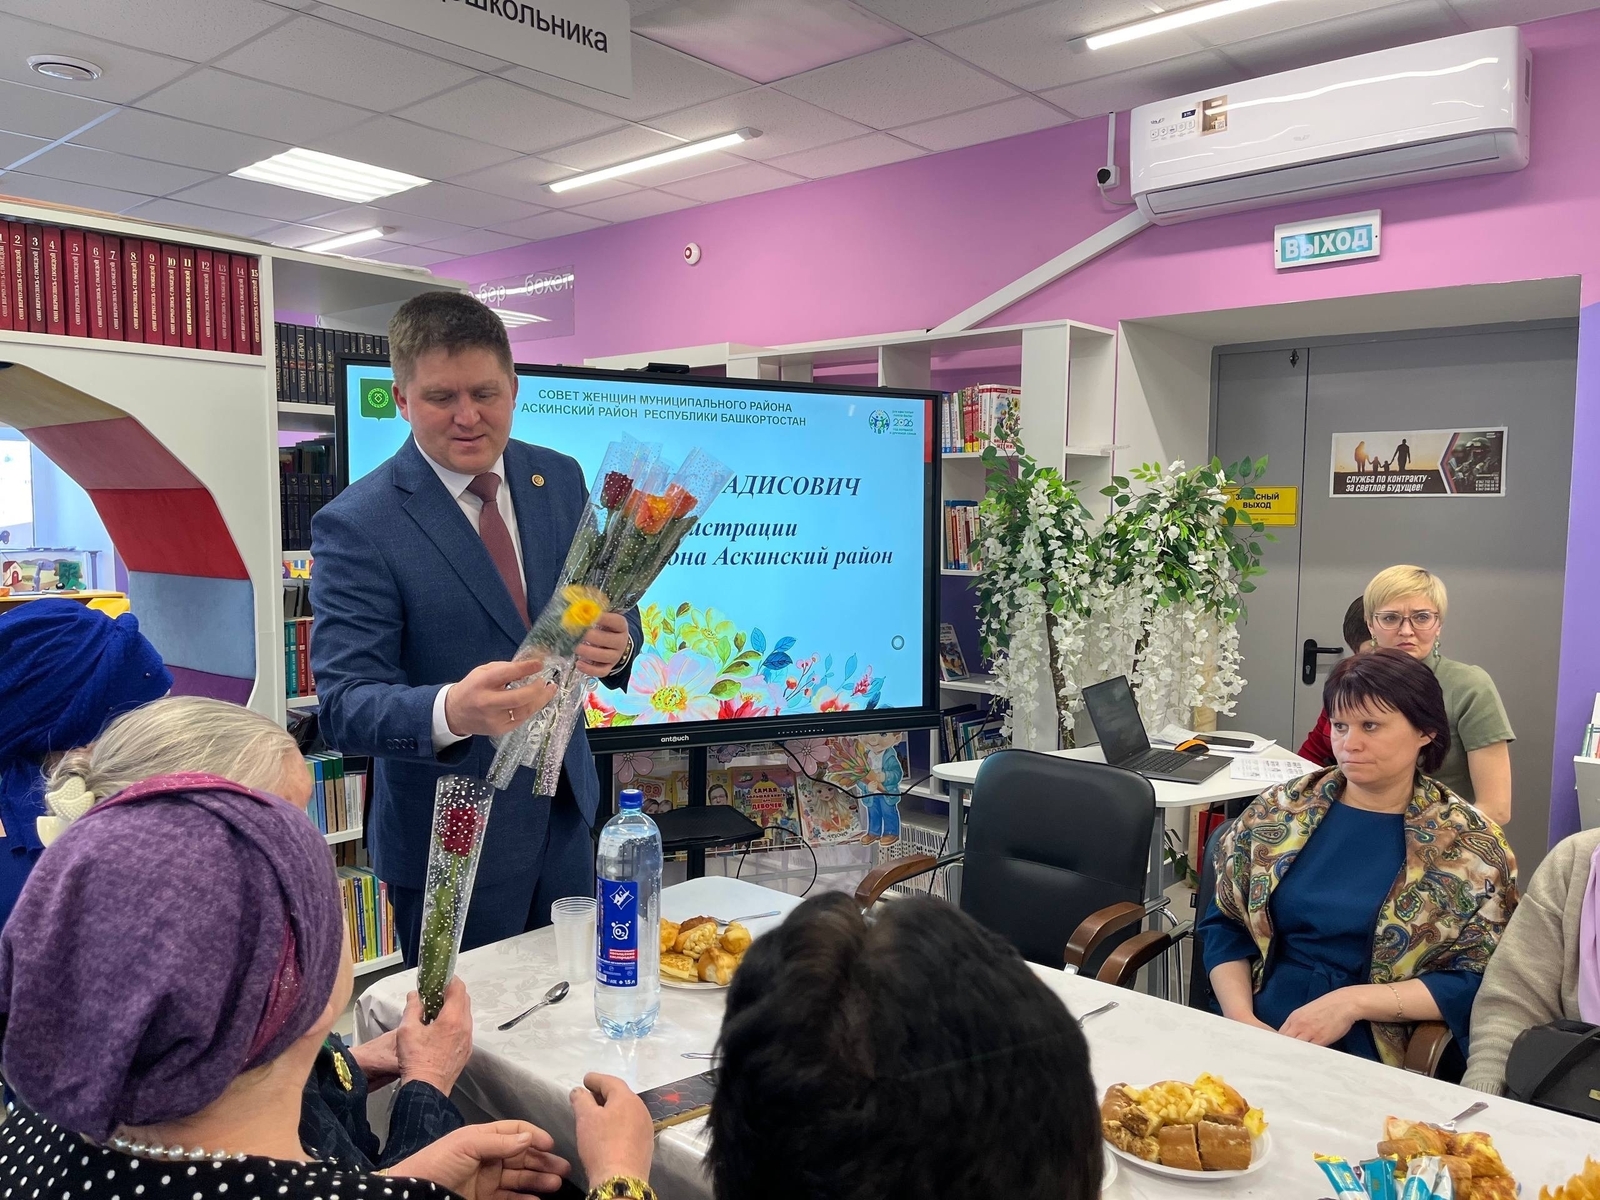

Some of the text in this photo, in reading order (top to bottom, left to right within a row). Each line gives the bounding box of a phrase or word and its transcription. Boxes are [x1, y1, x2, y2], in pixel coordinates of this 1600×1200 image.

[440, 0, 608, 53] школьника
[15, 235, 20, 243] 2
[33, 237, 38, 246] 3
[1284, 228, 1369, 259] ВЫХОД
[50, 241, 55, 249] 4
[73, 244, 78, 252] 5
[110, 251, 115, 259] 7
[150, 254, 154, 262] 9
[168, 257, 175, 266] 10
[538, 390, 792, 412] СОВЕТ ЖЕНЩИН МУНИЦИПАЛЬНОГО РАЙОНА
[521, 403, 806, 426] АСКИНСКИЙ РАЙОН РЕСПУБЛИКИ БАШКОРТОСТАН
[893, 418, 913, 427] 2026
[1387, 475, 1427, 483] КОНТРАКТУ
[1236, 492, 1279, 501] ЗСНЫЙ
[688, 521, 798, 541] истрации
[667, 546, 893, 570] она Аскинский район
